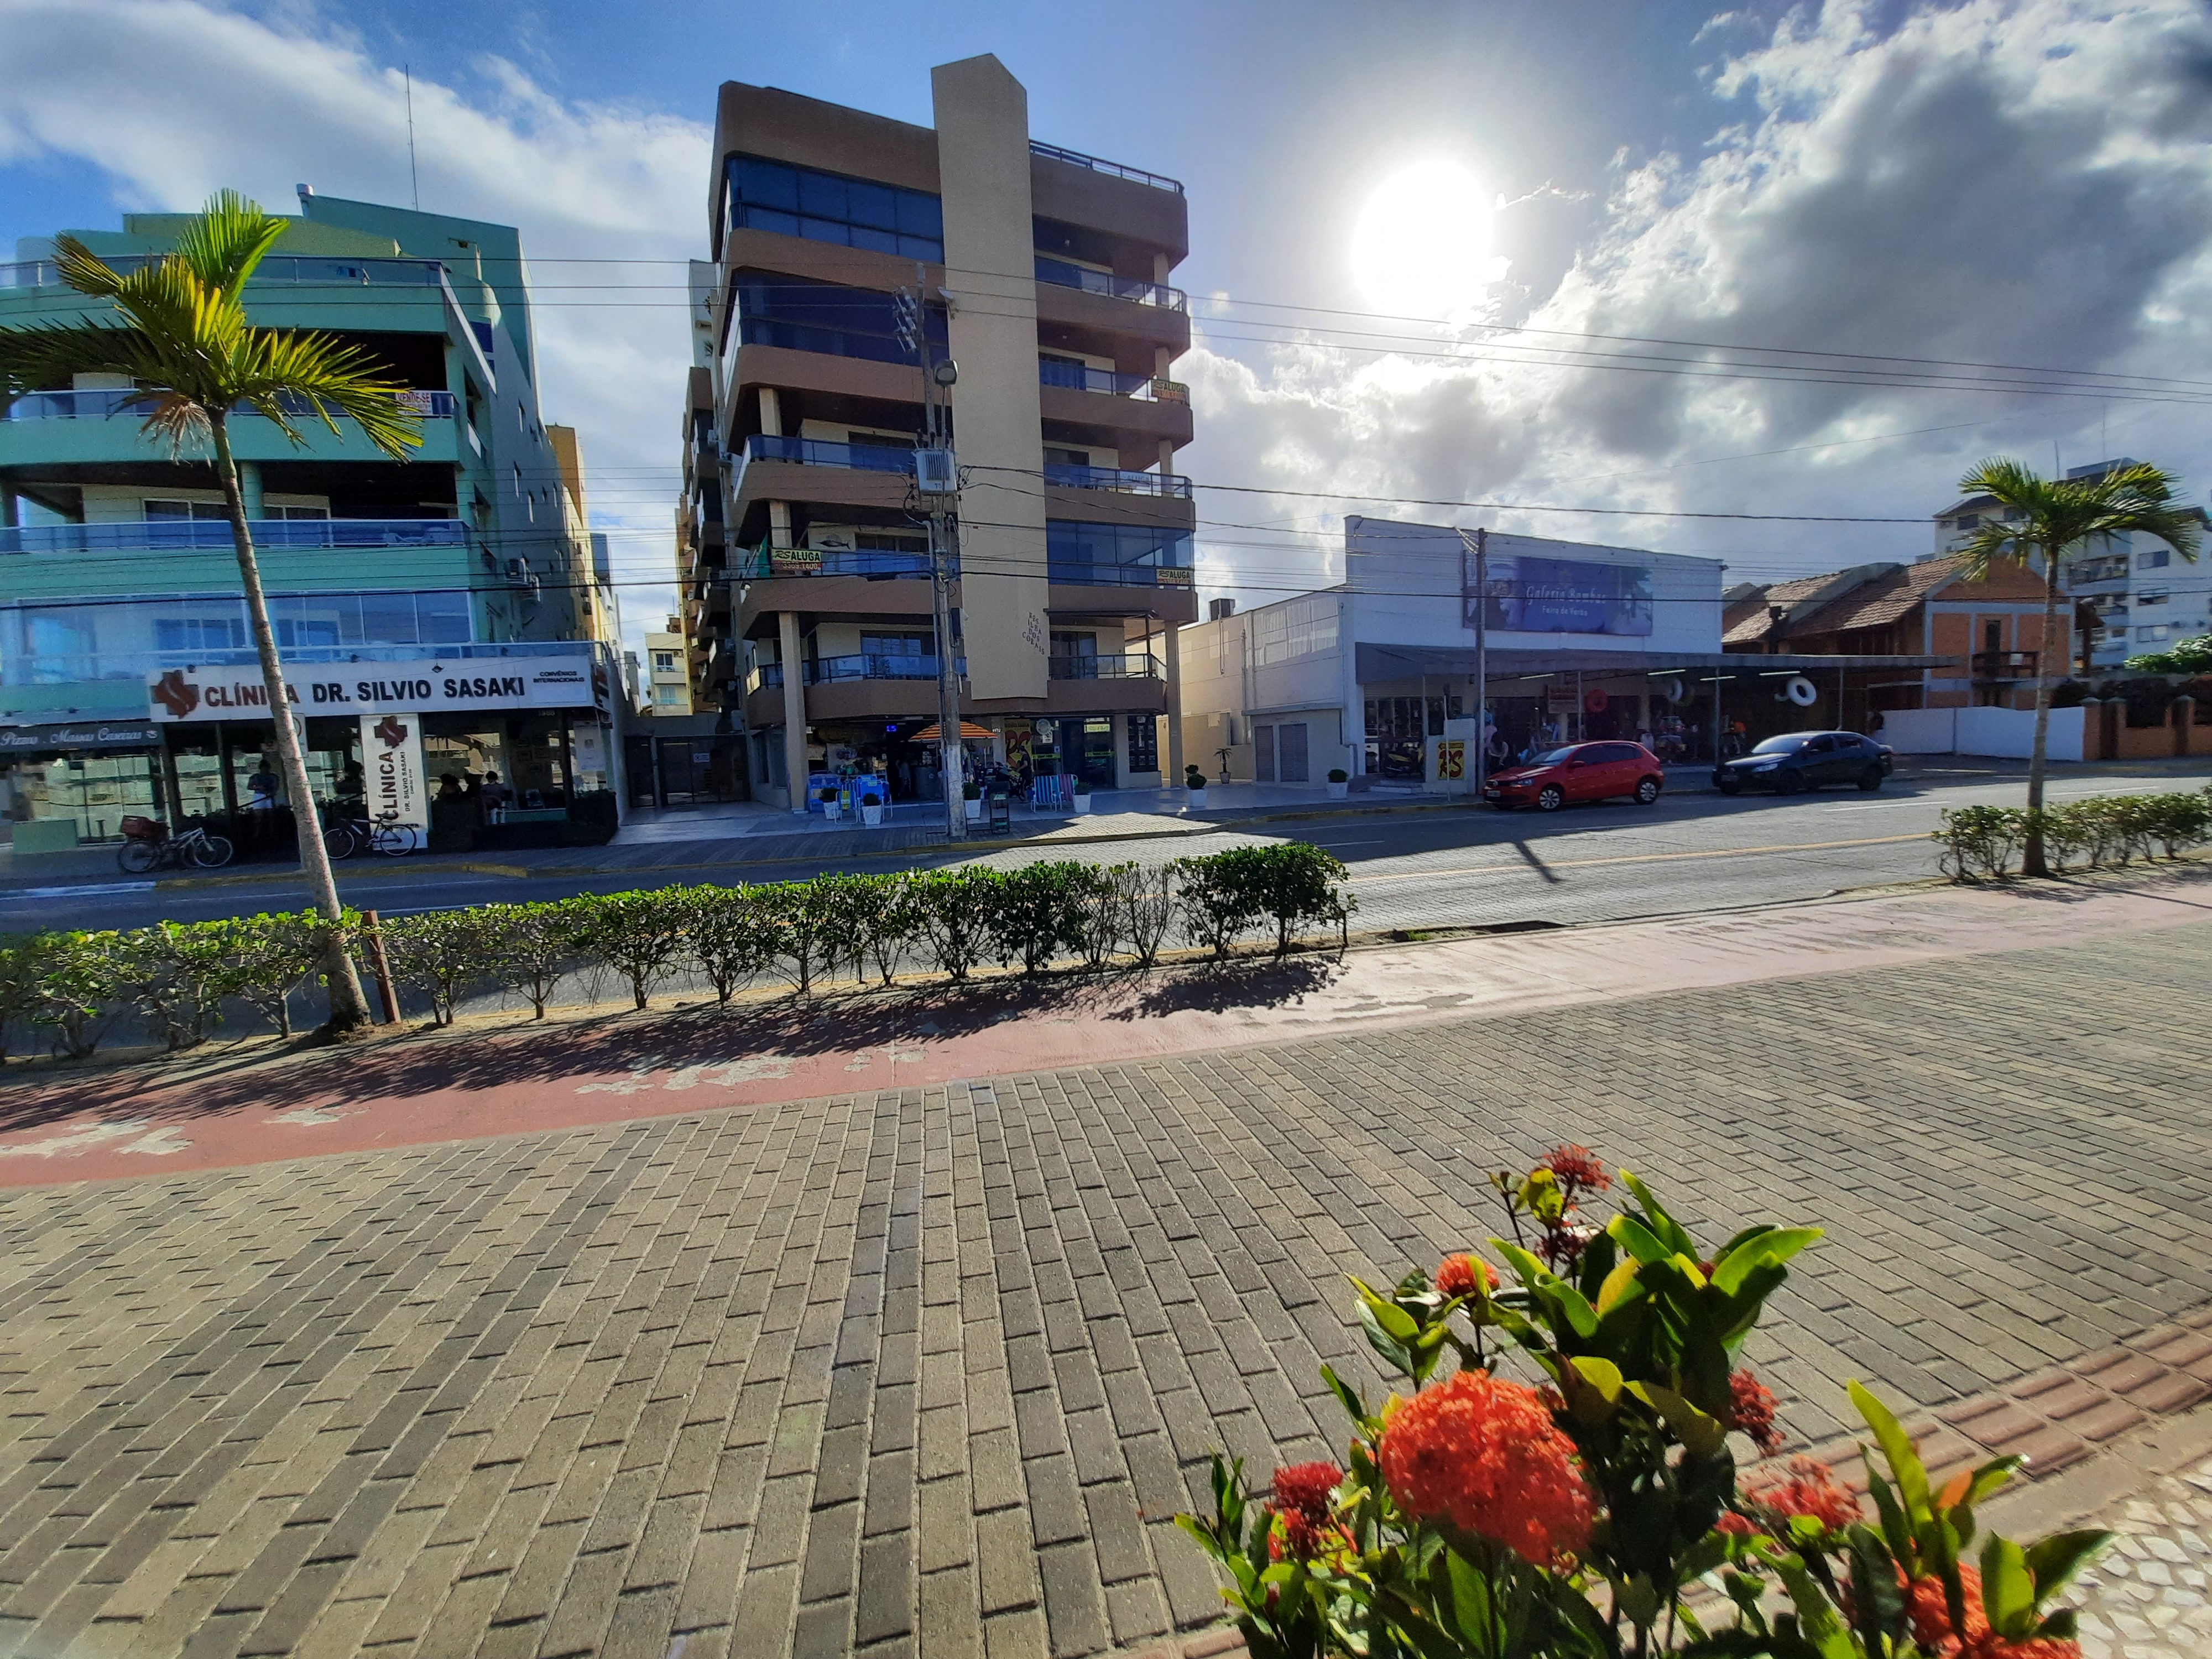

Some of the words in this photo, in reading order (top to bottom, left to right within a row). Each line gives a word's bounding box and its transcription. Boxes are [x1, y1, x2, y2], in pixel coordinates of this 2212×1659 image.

[1164, 382, 1185, 393] ALUGA
[791, 551, 820, 561] ALUGA
[1170, 571, 1191, 579] ALUGA
[1526, 585, 1566, 605] Galeria
[1561, 606, 1568, 614] de
[1022, 632, 1045, 655] CORAIS
[1029, 628, 1040, 642] DOS
[205, 682, 301, 706] CLÍNIA
[312, 683, 351, 703] DR.
[357, 680, 432, 701] SILVIO
[444, 677, 525, 698] SASAKI
[400, 752, 408, 776] SASAKI
[378, 752, 399, 820] CLÍNICA
